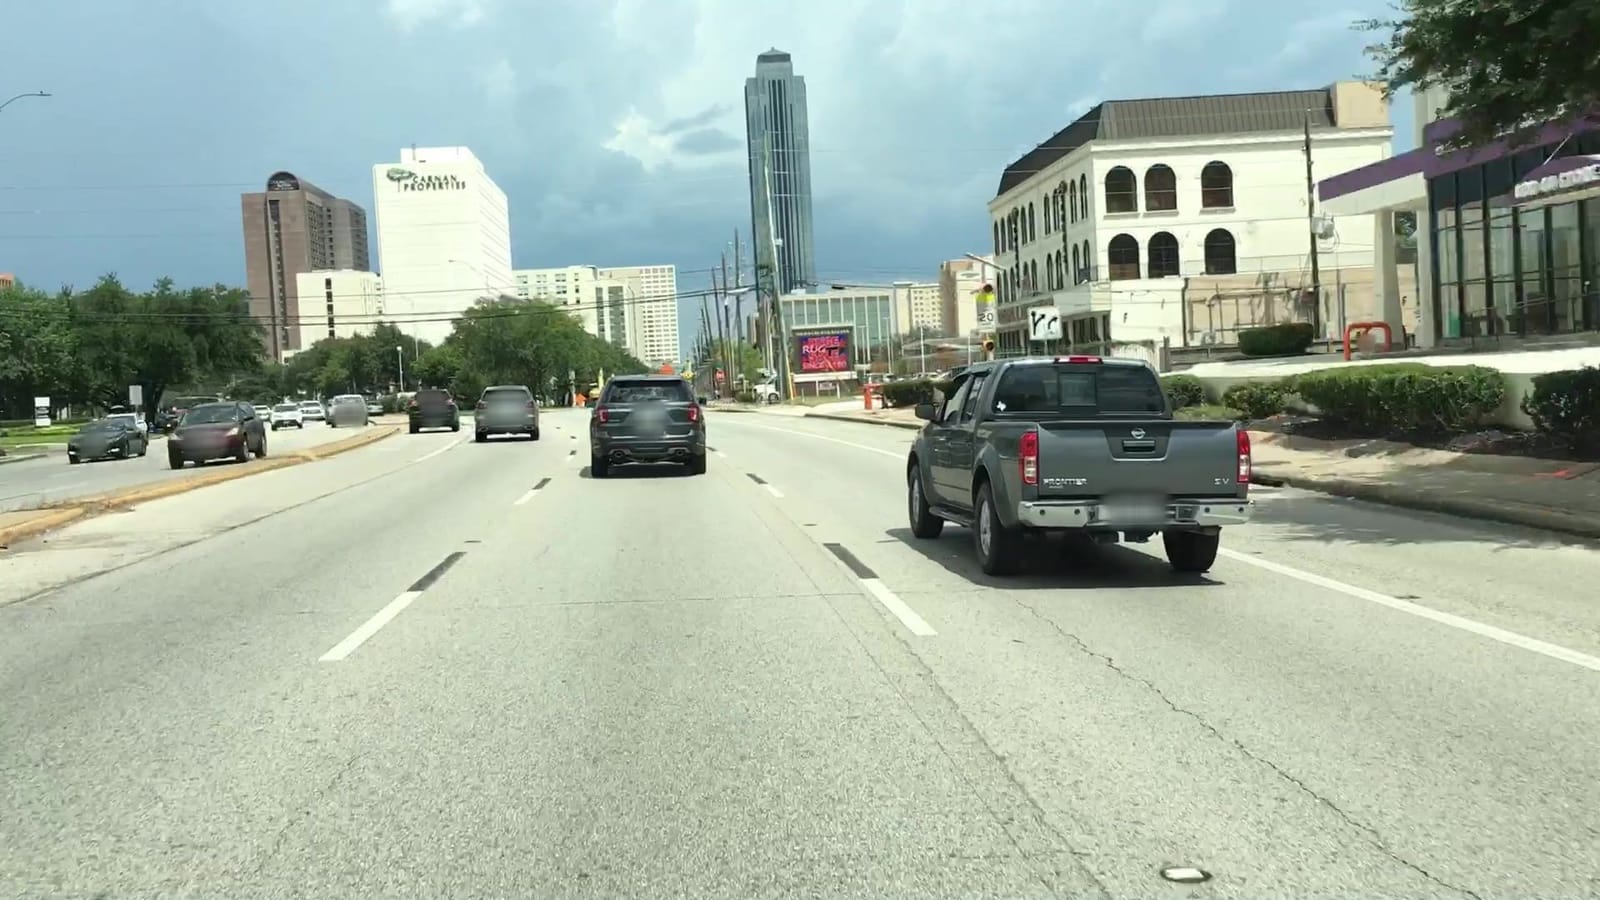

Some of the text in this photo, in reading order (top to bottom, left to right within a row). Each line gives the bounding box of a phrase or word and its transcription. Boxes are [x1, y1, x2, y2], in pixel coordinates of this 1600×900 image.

[403, 181, 466, 192] PROPERTIES
[977, 312, 993, 322] 20
[1043, 478, 1087, 486] FRONTIER
[1214, 477, 1230, 485] SV
